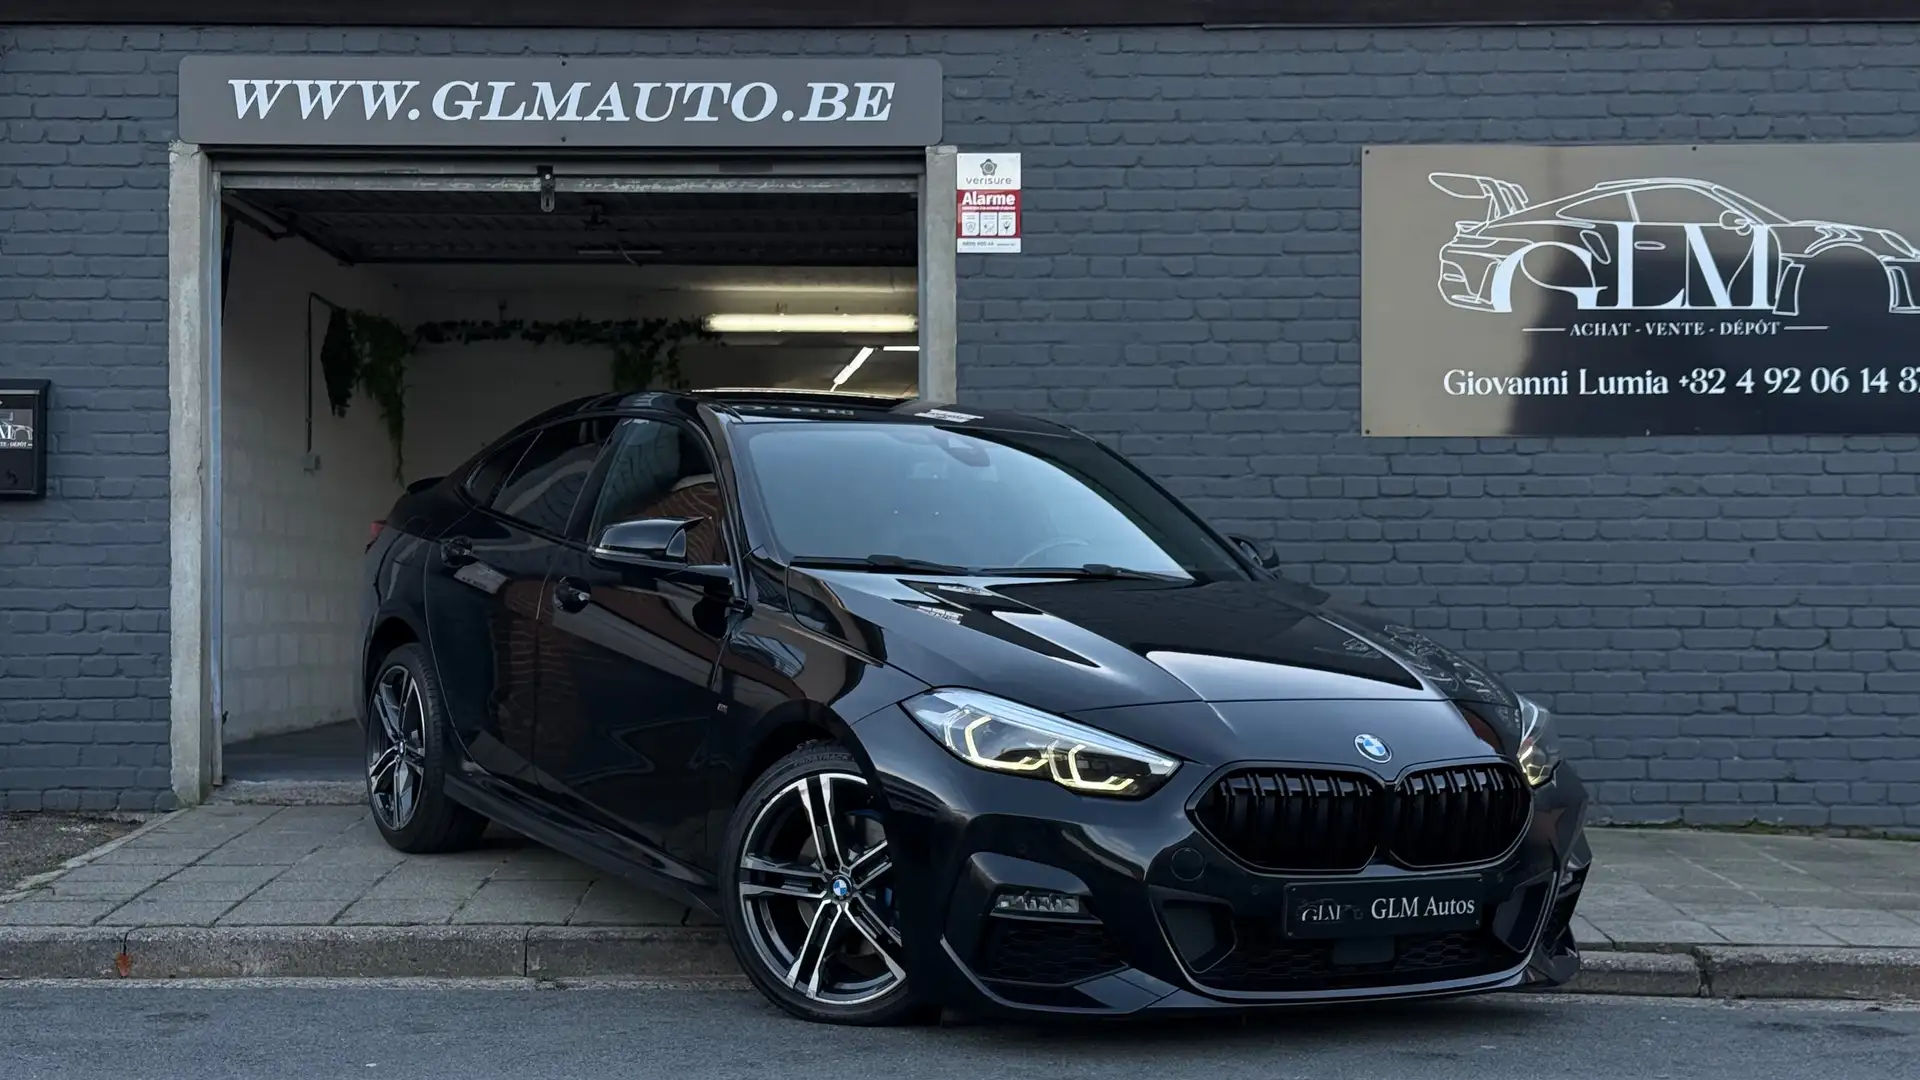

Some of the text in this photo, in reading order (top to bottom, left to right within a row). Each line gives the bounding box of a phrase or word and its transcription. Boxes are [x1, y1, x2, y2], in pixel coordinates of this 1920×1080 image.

[227, 79, 896, 122] WWW.GLMAUTO.BE
[965, 177, 1012, 185] verisure
[962, 190, 1016, 206] Alarme
[1490, 221, 1774, 313] GLM
[1569, 322, 1631, 337] ACHAT
[1645, 321, 1705, 336] VENTE
[1443, 366, 1920, 396] Giovanni Lumia +32 4 92 06 14 3
[1371, 896, 1420, 920] GLM
[1424, 895, 1475, 916] Autos
